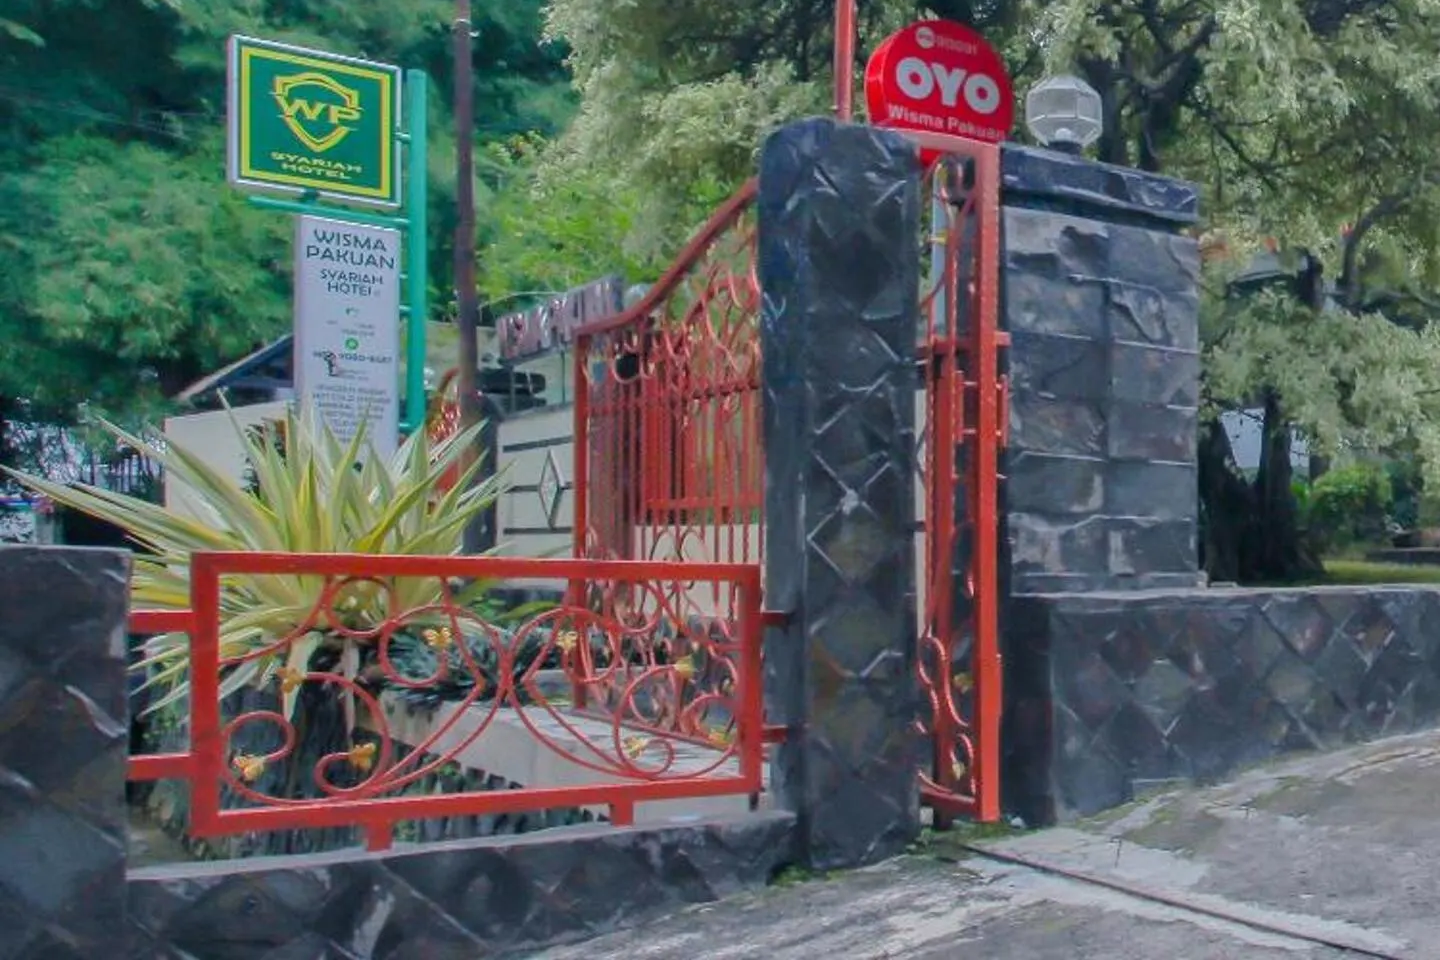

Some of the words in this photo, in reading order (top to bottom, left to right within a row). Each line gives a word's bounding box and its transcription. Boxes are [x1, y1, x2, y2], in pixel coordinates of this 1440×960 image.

[895, 56, 1000, 115] OYO
[888, 104, 945, 128] Wisma
[270, 151, 363, 174] SYARIAH
[281, 162, 353, 180] HOTEL
[313, 227, 388, 253] WISMA
[306, 244, 395, 270] PAKUAN
[320, 268, 385, 285] SYARIAH
